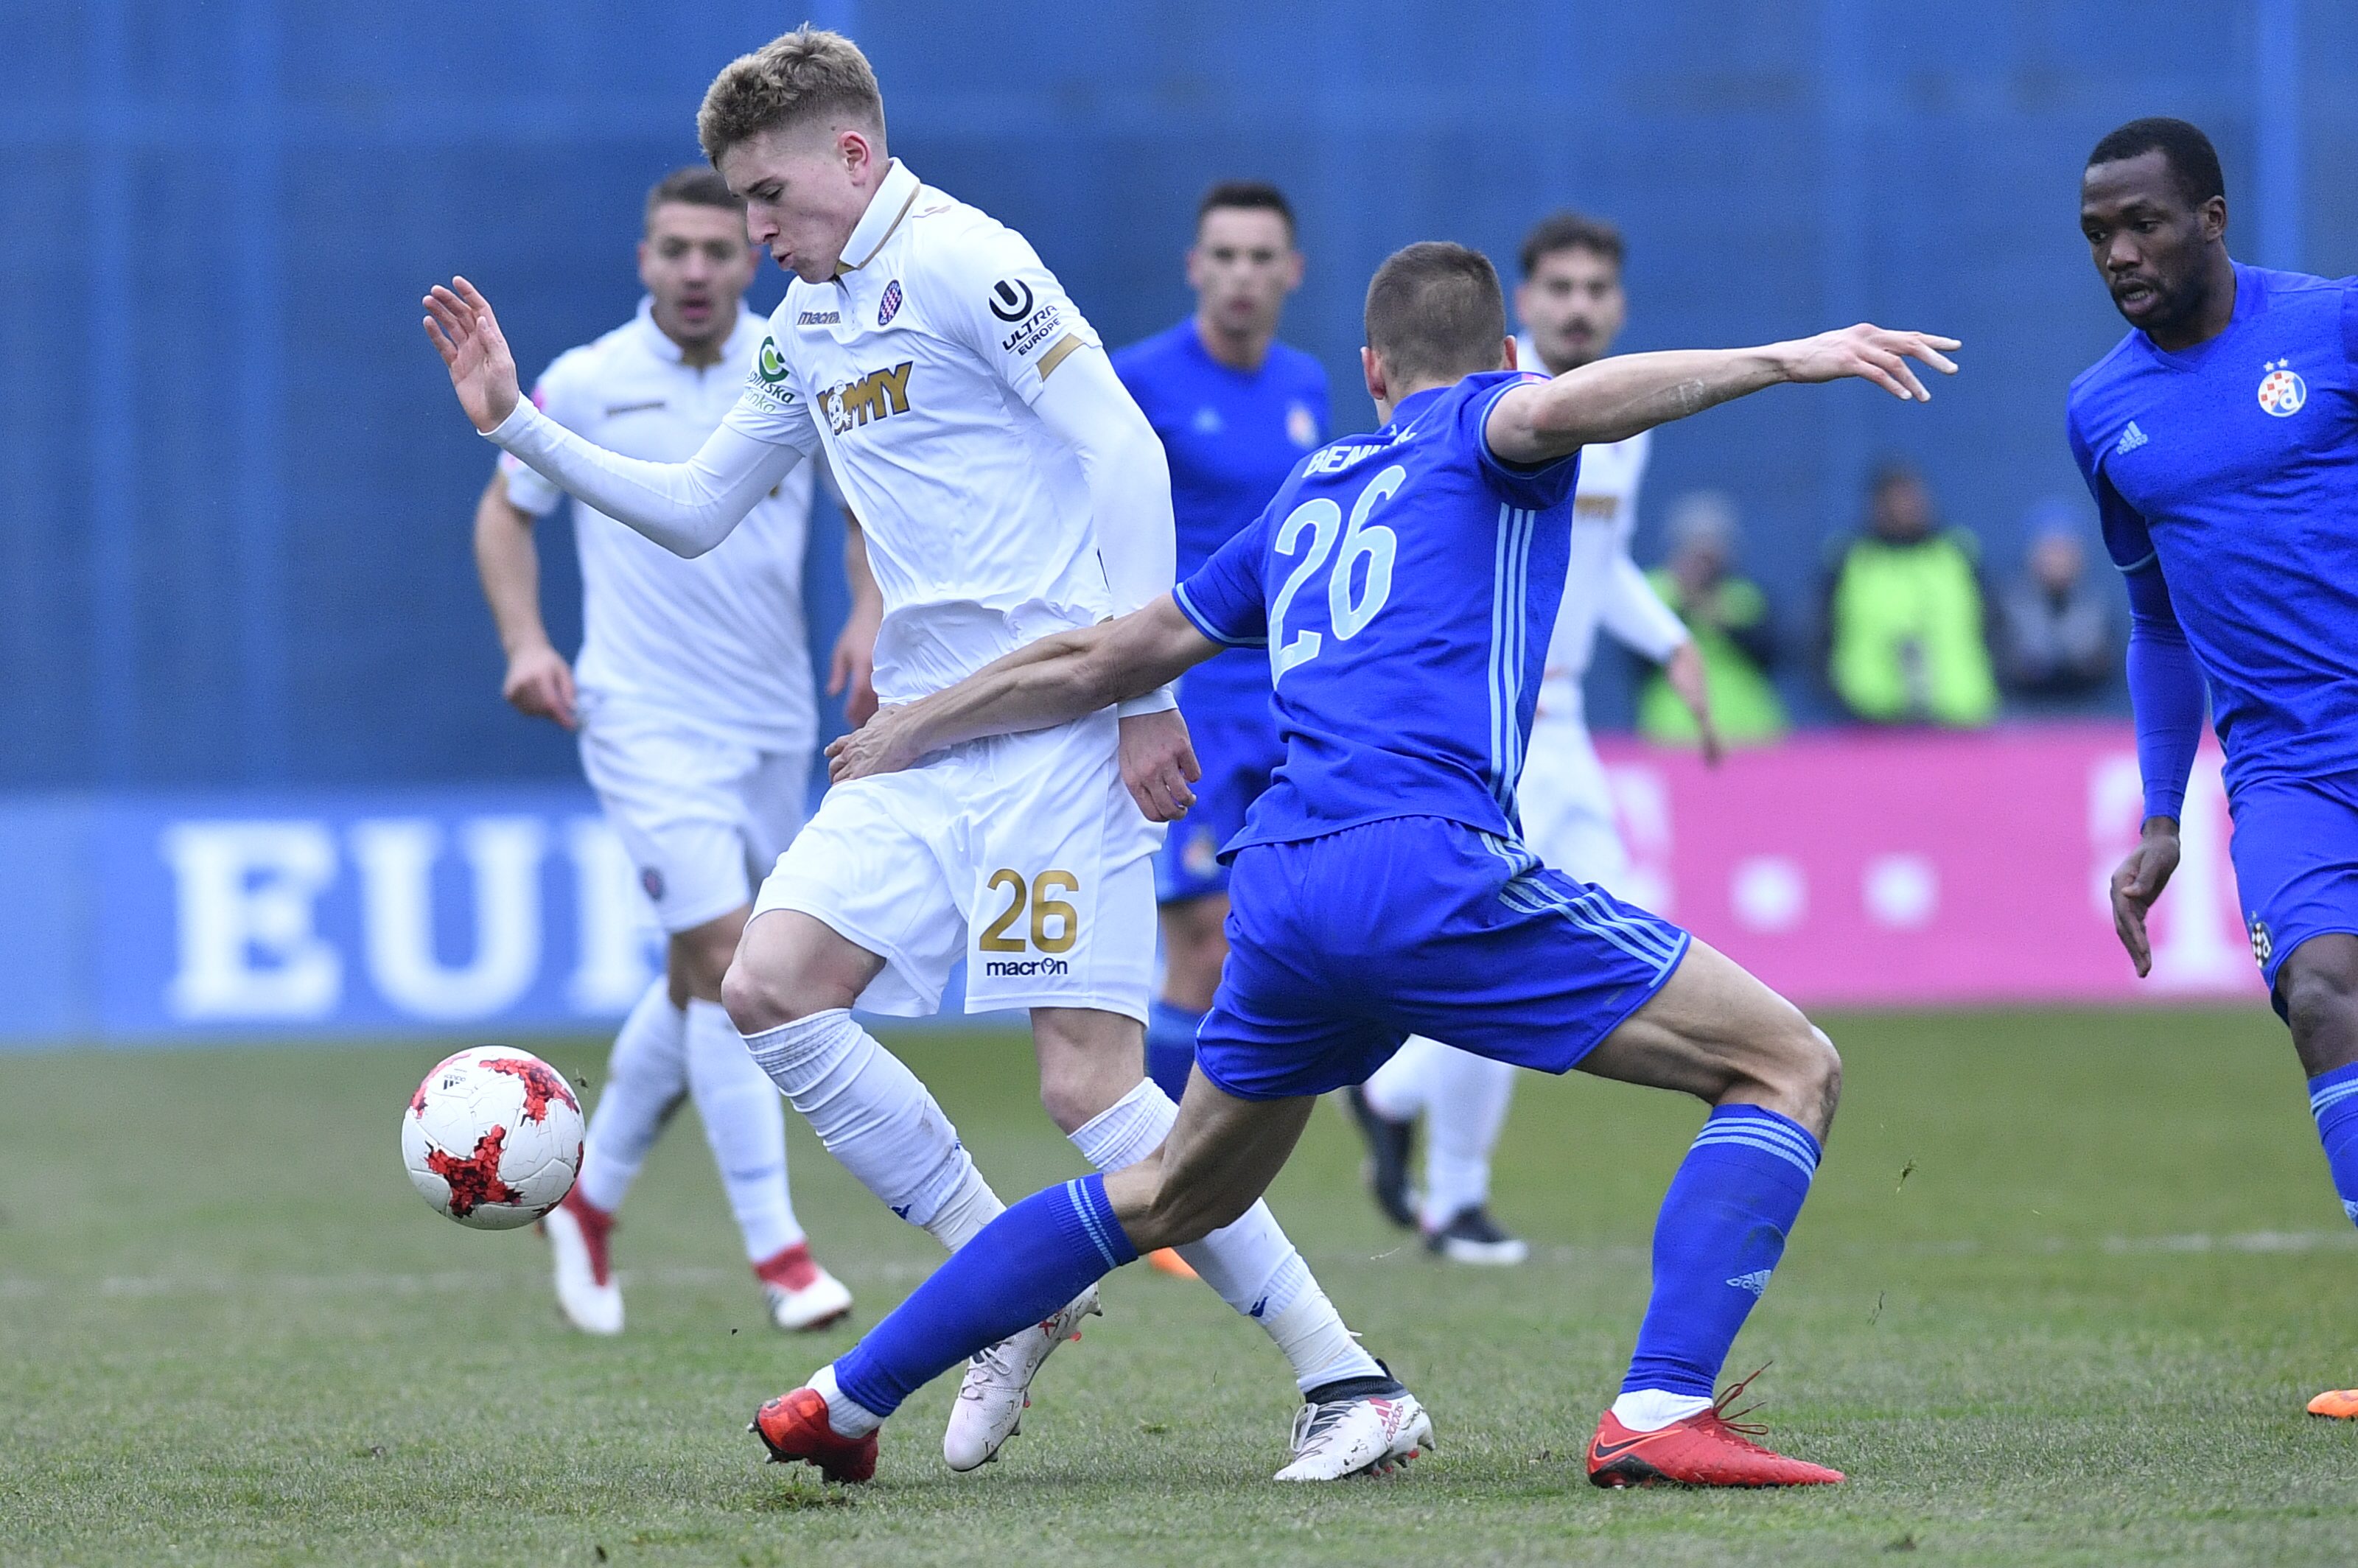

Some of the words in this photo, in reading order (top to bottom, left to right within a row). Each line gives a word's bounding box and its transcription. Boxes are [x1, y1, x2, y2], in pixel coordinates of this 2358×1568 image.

[797, 311, 842, 326] macro
[1002, 305, 1058, 351] ULTRA
[1017, 318, 1061, 356] EUROPE
[1268, 464, 1407, 691] 26
[979, 868, 1080, 953] 26
[986, 957, 1068, 976] macron
